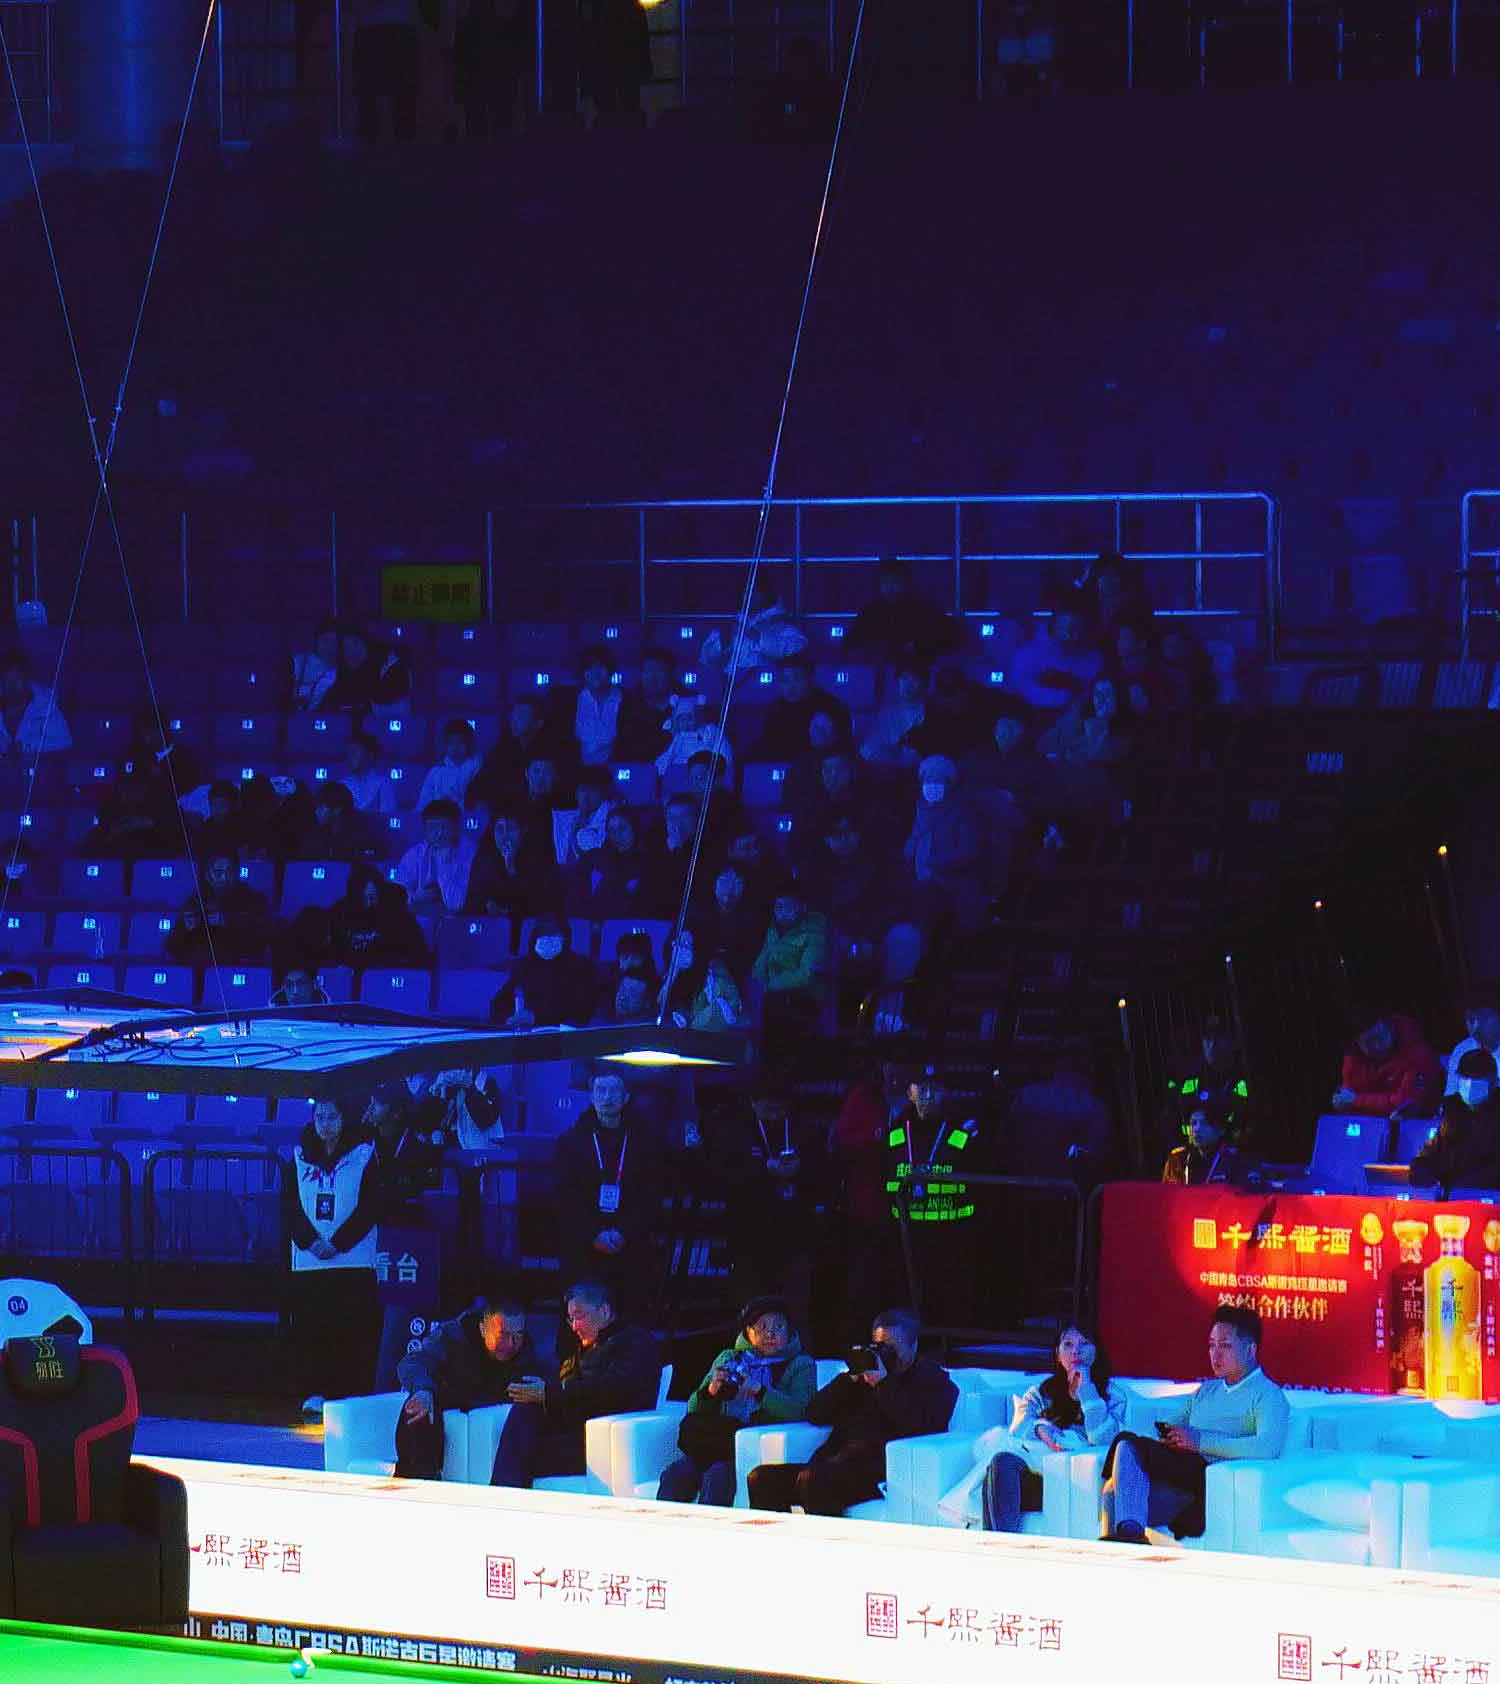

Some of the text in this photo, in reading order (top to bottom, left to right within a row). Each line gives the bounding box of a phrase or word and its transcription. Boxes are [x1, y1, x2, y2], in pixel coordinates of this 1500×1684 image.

[189, 1532, 303, 1576] 熙酱酒
[522, 1566, 668, 1612] 千熙酱酒
[906, 1604, 1064, 1652] 千熙酱酒
